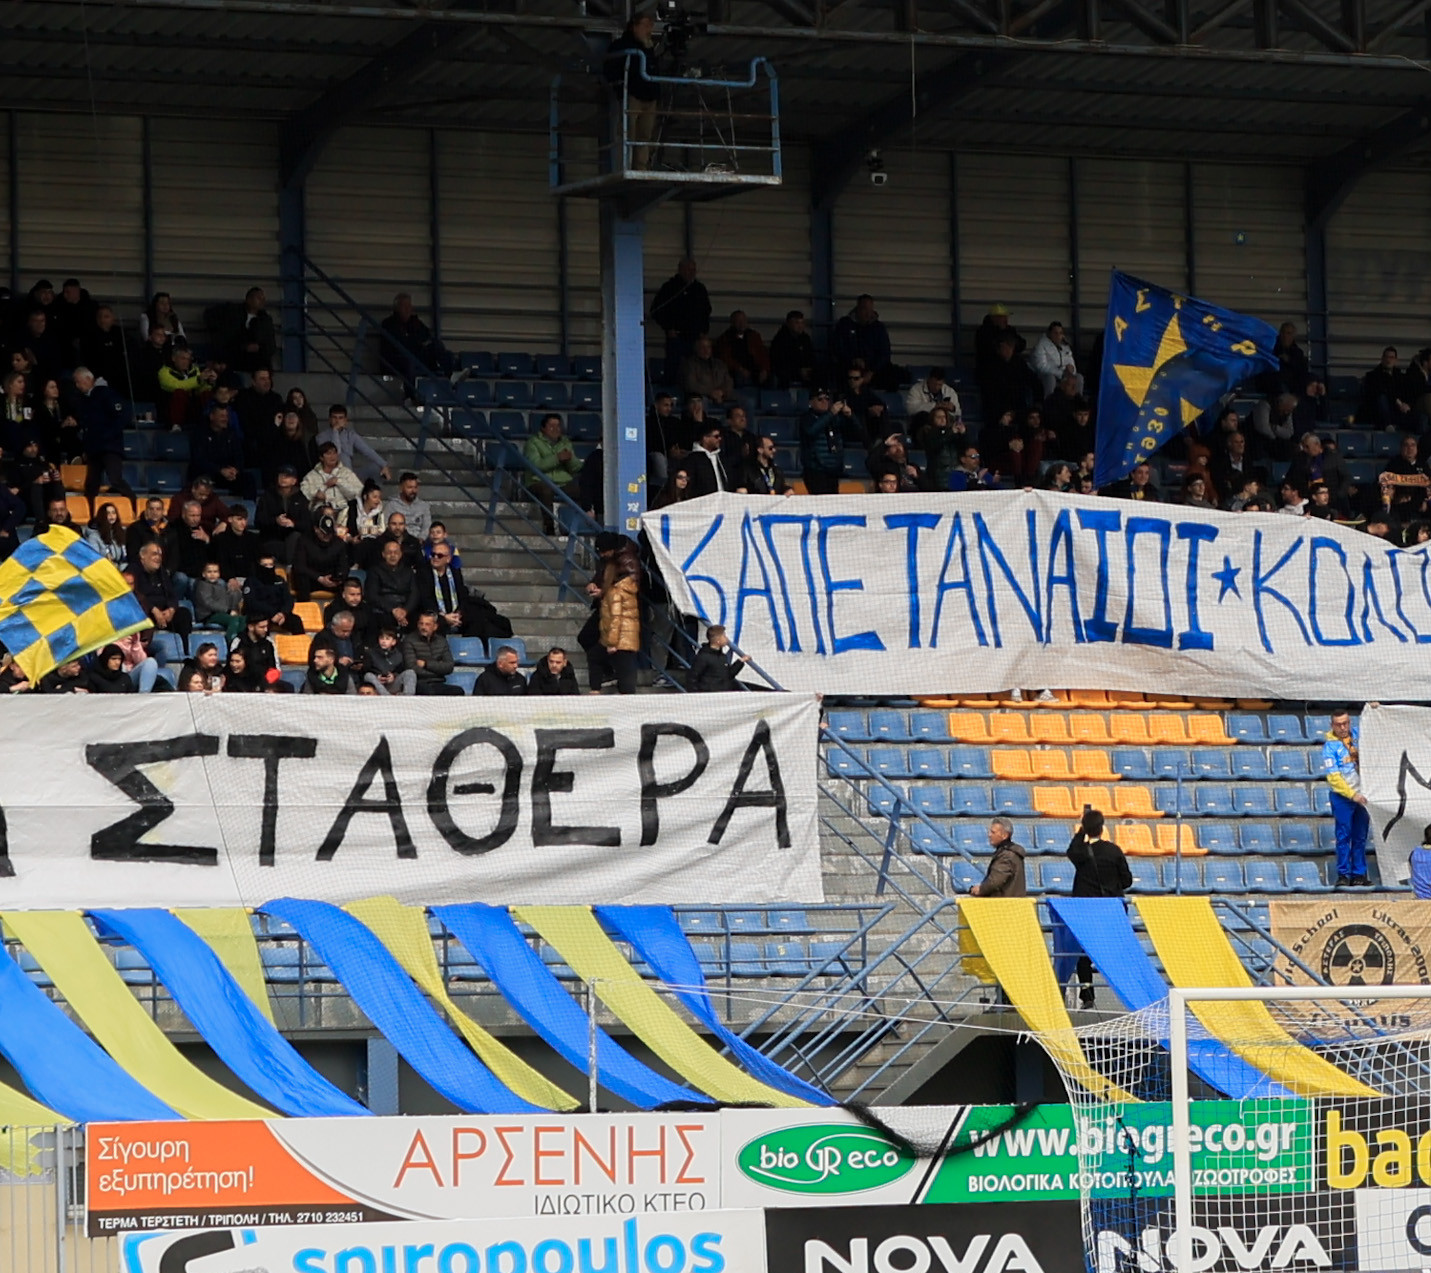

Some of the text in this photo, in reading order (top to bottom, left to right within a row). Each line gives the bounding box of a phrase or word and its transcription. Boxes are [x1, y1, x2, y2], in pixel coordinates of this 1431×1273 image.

[85, 717, 793, 868] ΣΤΑΘΕΡΑ
[98, 1136, 190, 1164] Σίγουρη
[393, 1124, 706, 1188] ΑΡΣΕΝΗΣ
[760, 1144, 798, 1170] bio
[847, 1150, 899, 1169] eco
[99, 1166, 254, 1196] εξυπηρέτηση!
[968, 1172, 1064, 1192] ΒΙΟΛΟΓΙΚΑ
[1193, 1168, 1297, 1187] ΖΩΟΤΡΟΦΕΣ
[534, 1192, 706, 1215] ΙΔΙΩΤΙΚΟ ΚΤΕΟ
[98, 1211, 364, 1230] ΤΕΡΜΑ ΤΕΡΣΤΕΤΗ ΤΡΙΠΟΛΗ ΤΗΛ. 2710 232451
